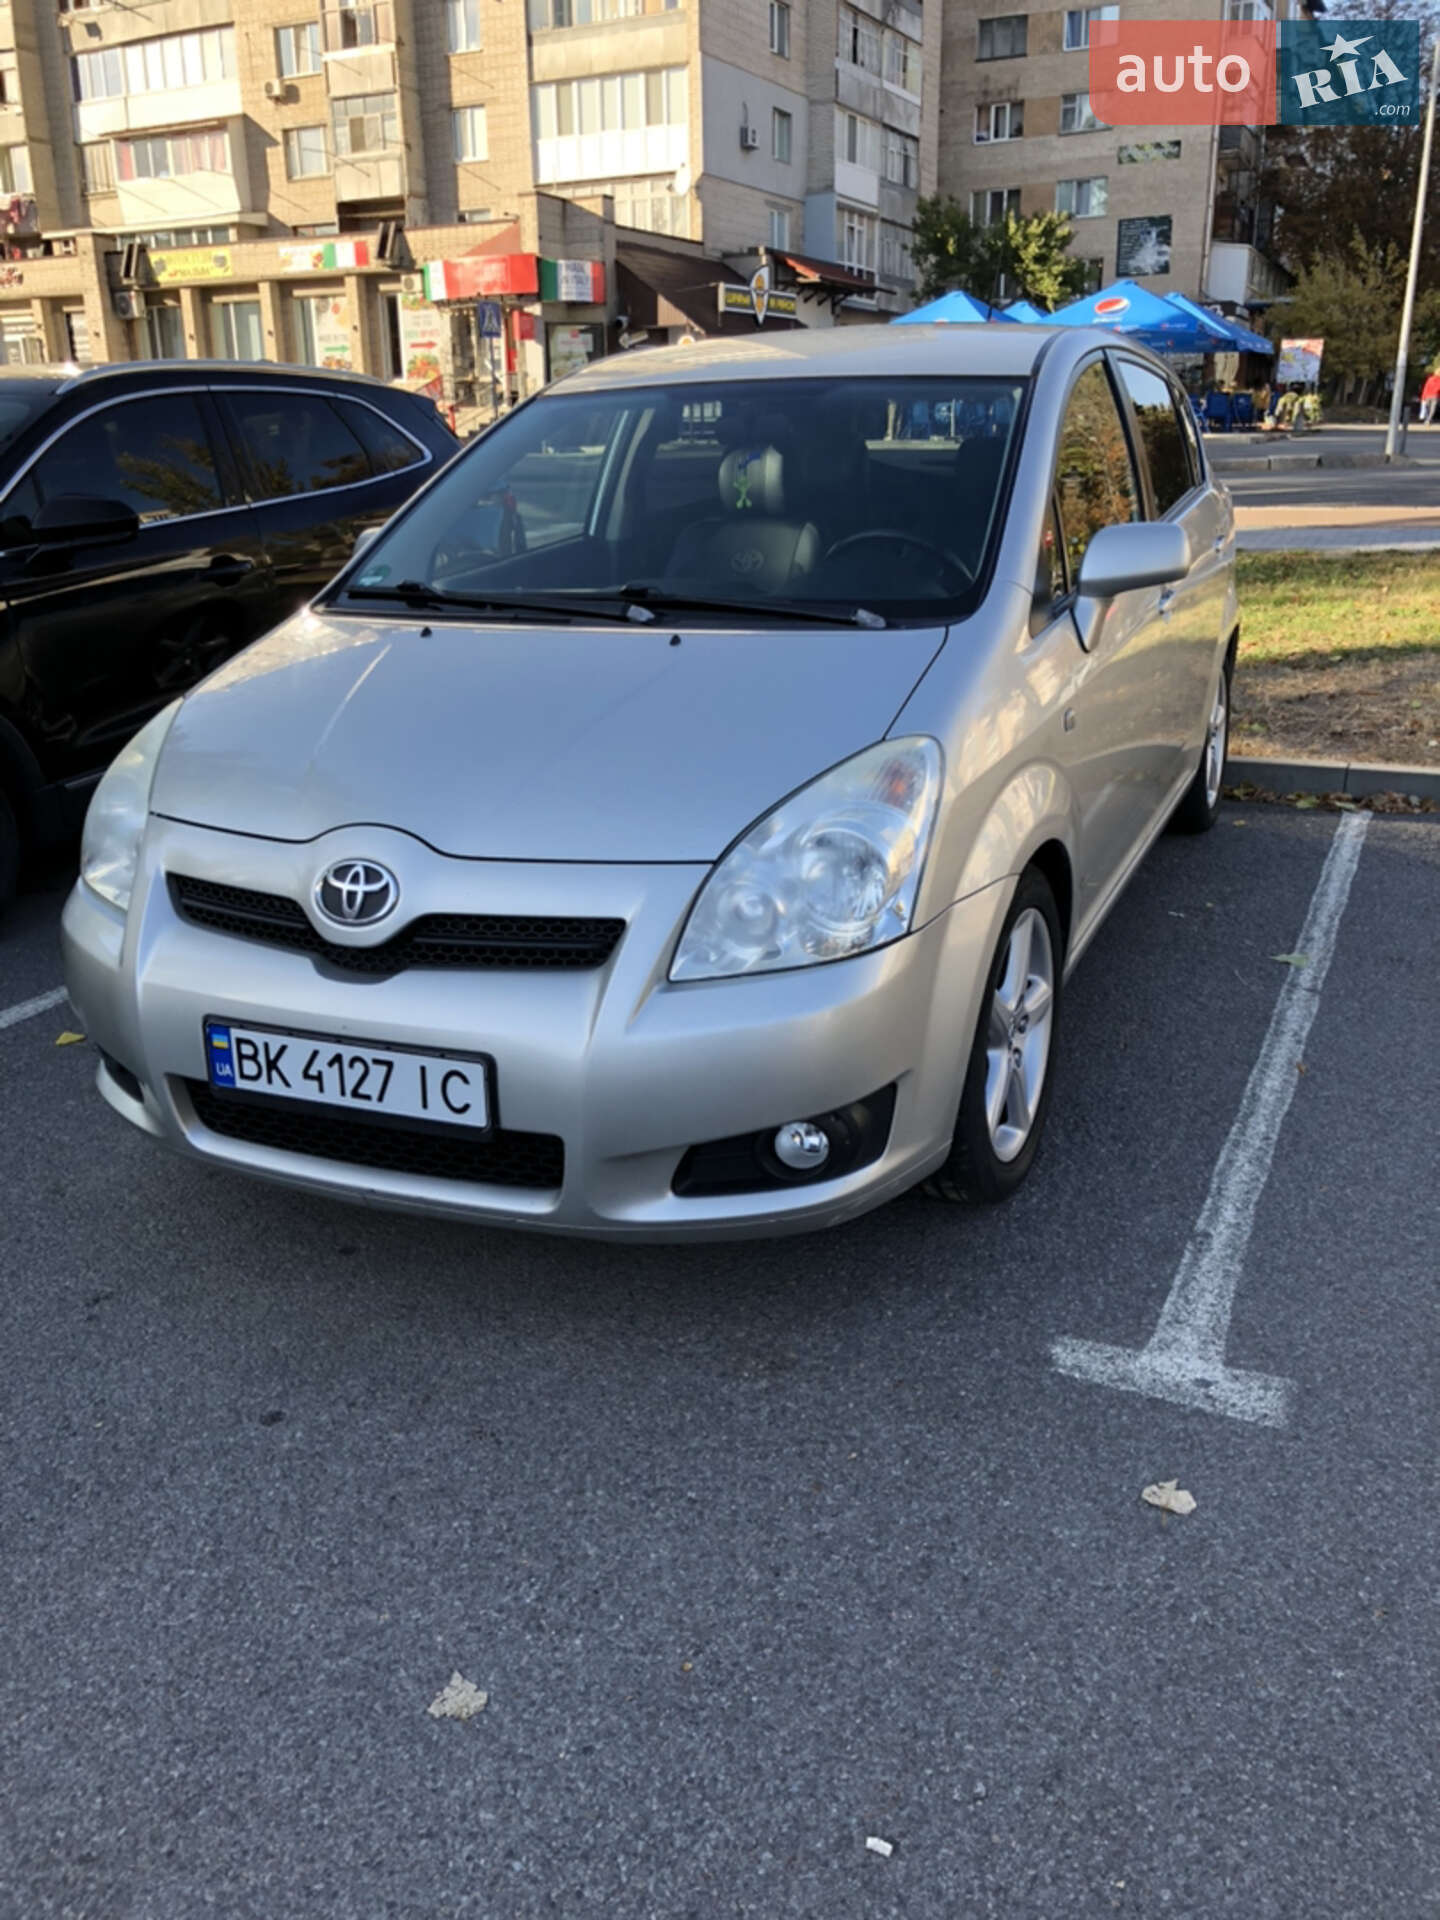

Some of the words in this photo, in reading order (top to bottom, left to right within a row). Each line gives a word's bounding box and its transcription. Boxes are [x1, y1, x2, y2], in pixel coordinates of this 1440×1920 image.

[215, 1063, 233, 1077] UA
[235, 1037, 292, 1089] BK
[302, 1049, 394, 1103] 4127
[420, 1065, 471, 1115] IC
